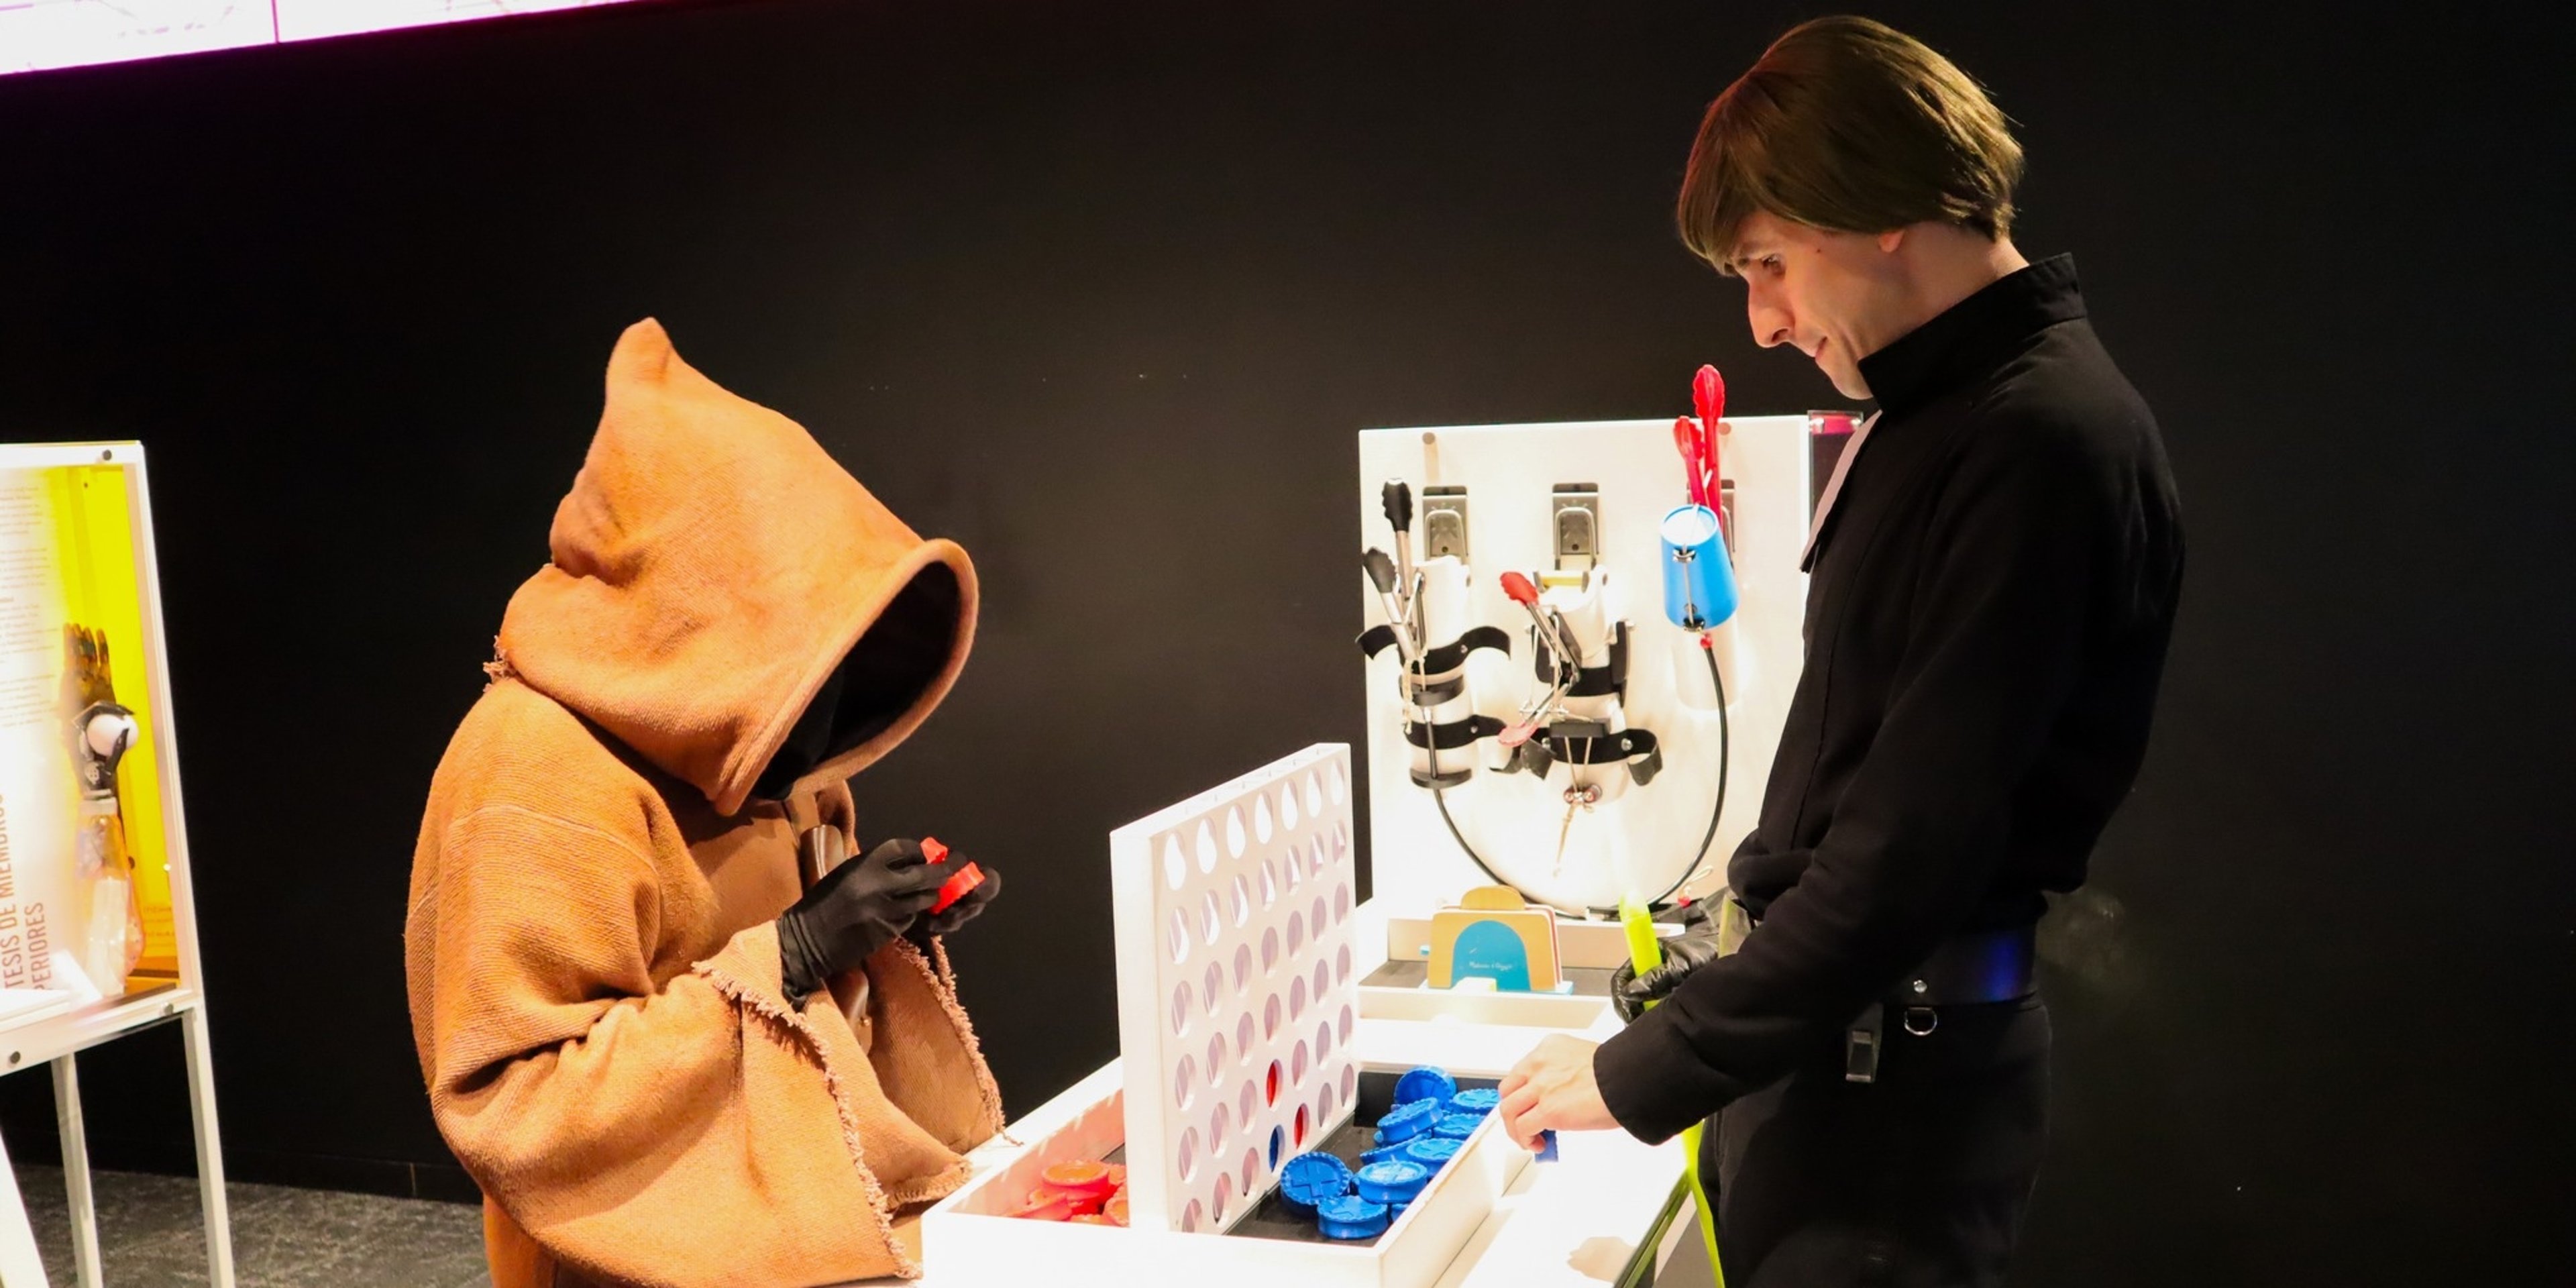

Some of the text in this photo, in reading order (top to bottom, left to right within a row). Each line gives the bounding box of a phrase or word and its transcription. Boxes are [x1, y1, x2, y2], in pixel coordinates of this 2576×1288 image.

[0, 794, 24, 989] TESIS DE MIEM
